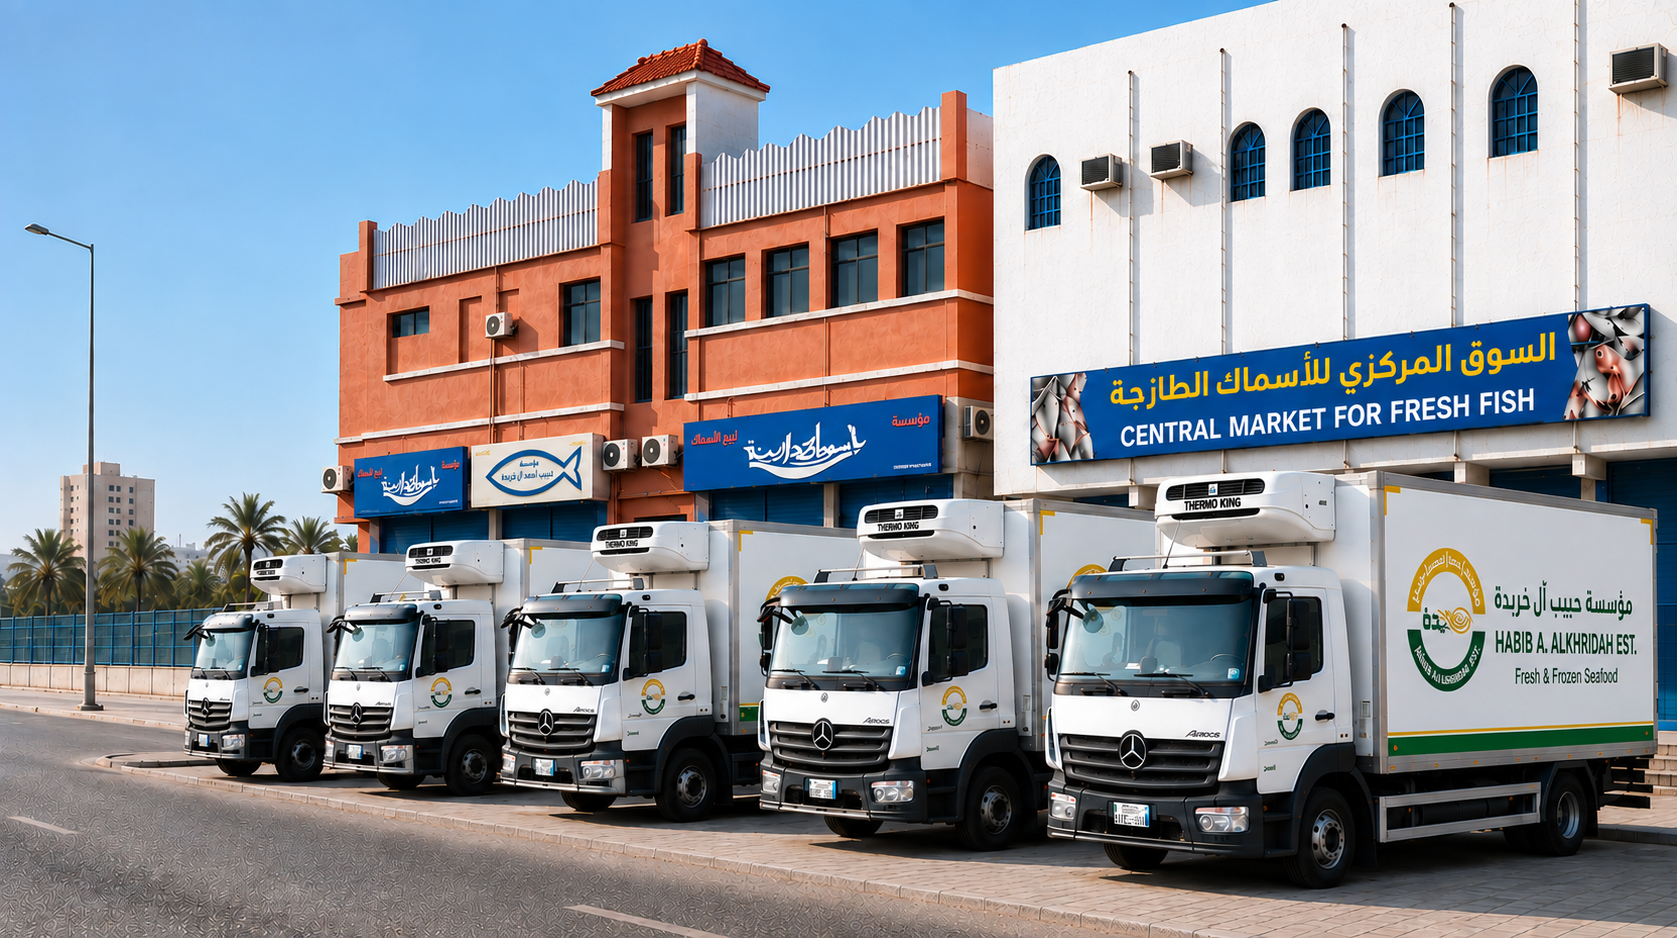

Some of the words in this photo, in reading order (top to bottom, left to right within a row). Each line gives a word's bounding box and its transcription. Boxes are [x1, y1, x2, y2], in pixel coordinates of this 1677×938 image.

[1339, 344, 1452, 395] المركزي
[1461, 332, 1556, 377] السوق
[1216, 351, 1330, 395] للأسماك
[1110, 370, 1209, 411] الطازجة
[891, 412, 930, 428] مؤسسة
[1120, 418, 1222, 447] CENTRAL
[1229, 407, 1327, 438] MARKET
[1334, 402, 1382, 428] FOR
[1390, 394, 1470, 424] FRESH
[1480, 387, 1534, 416] FISH
[1184, 498, 1218, 511] THERMO
[1220, 497, 1241, 508] KING
[1494, 586, 1531, 618] خريدة
[1549, 596, 1582, 619] حبيب
[1585, 590, 1633, 622] مؤسسة
[1495, 630, 1534, 654] HABIB
[1535, 631, 1548, 654] A.
[1550, 631, 1614, 655] ALKHRIDAH
[1616, 633, 1638, 656] EST.
[1515, 667, 1541, 685] Fresh
[1542, 667, 1550, 685] &
[1552, 667, 1582, 684] Frozen
[1584, 667, 1618, 684] Seafood
